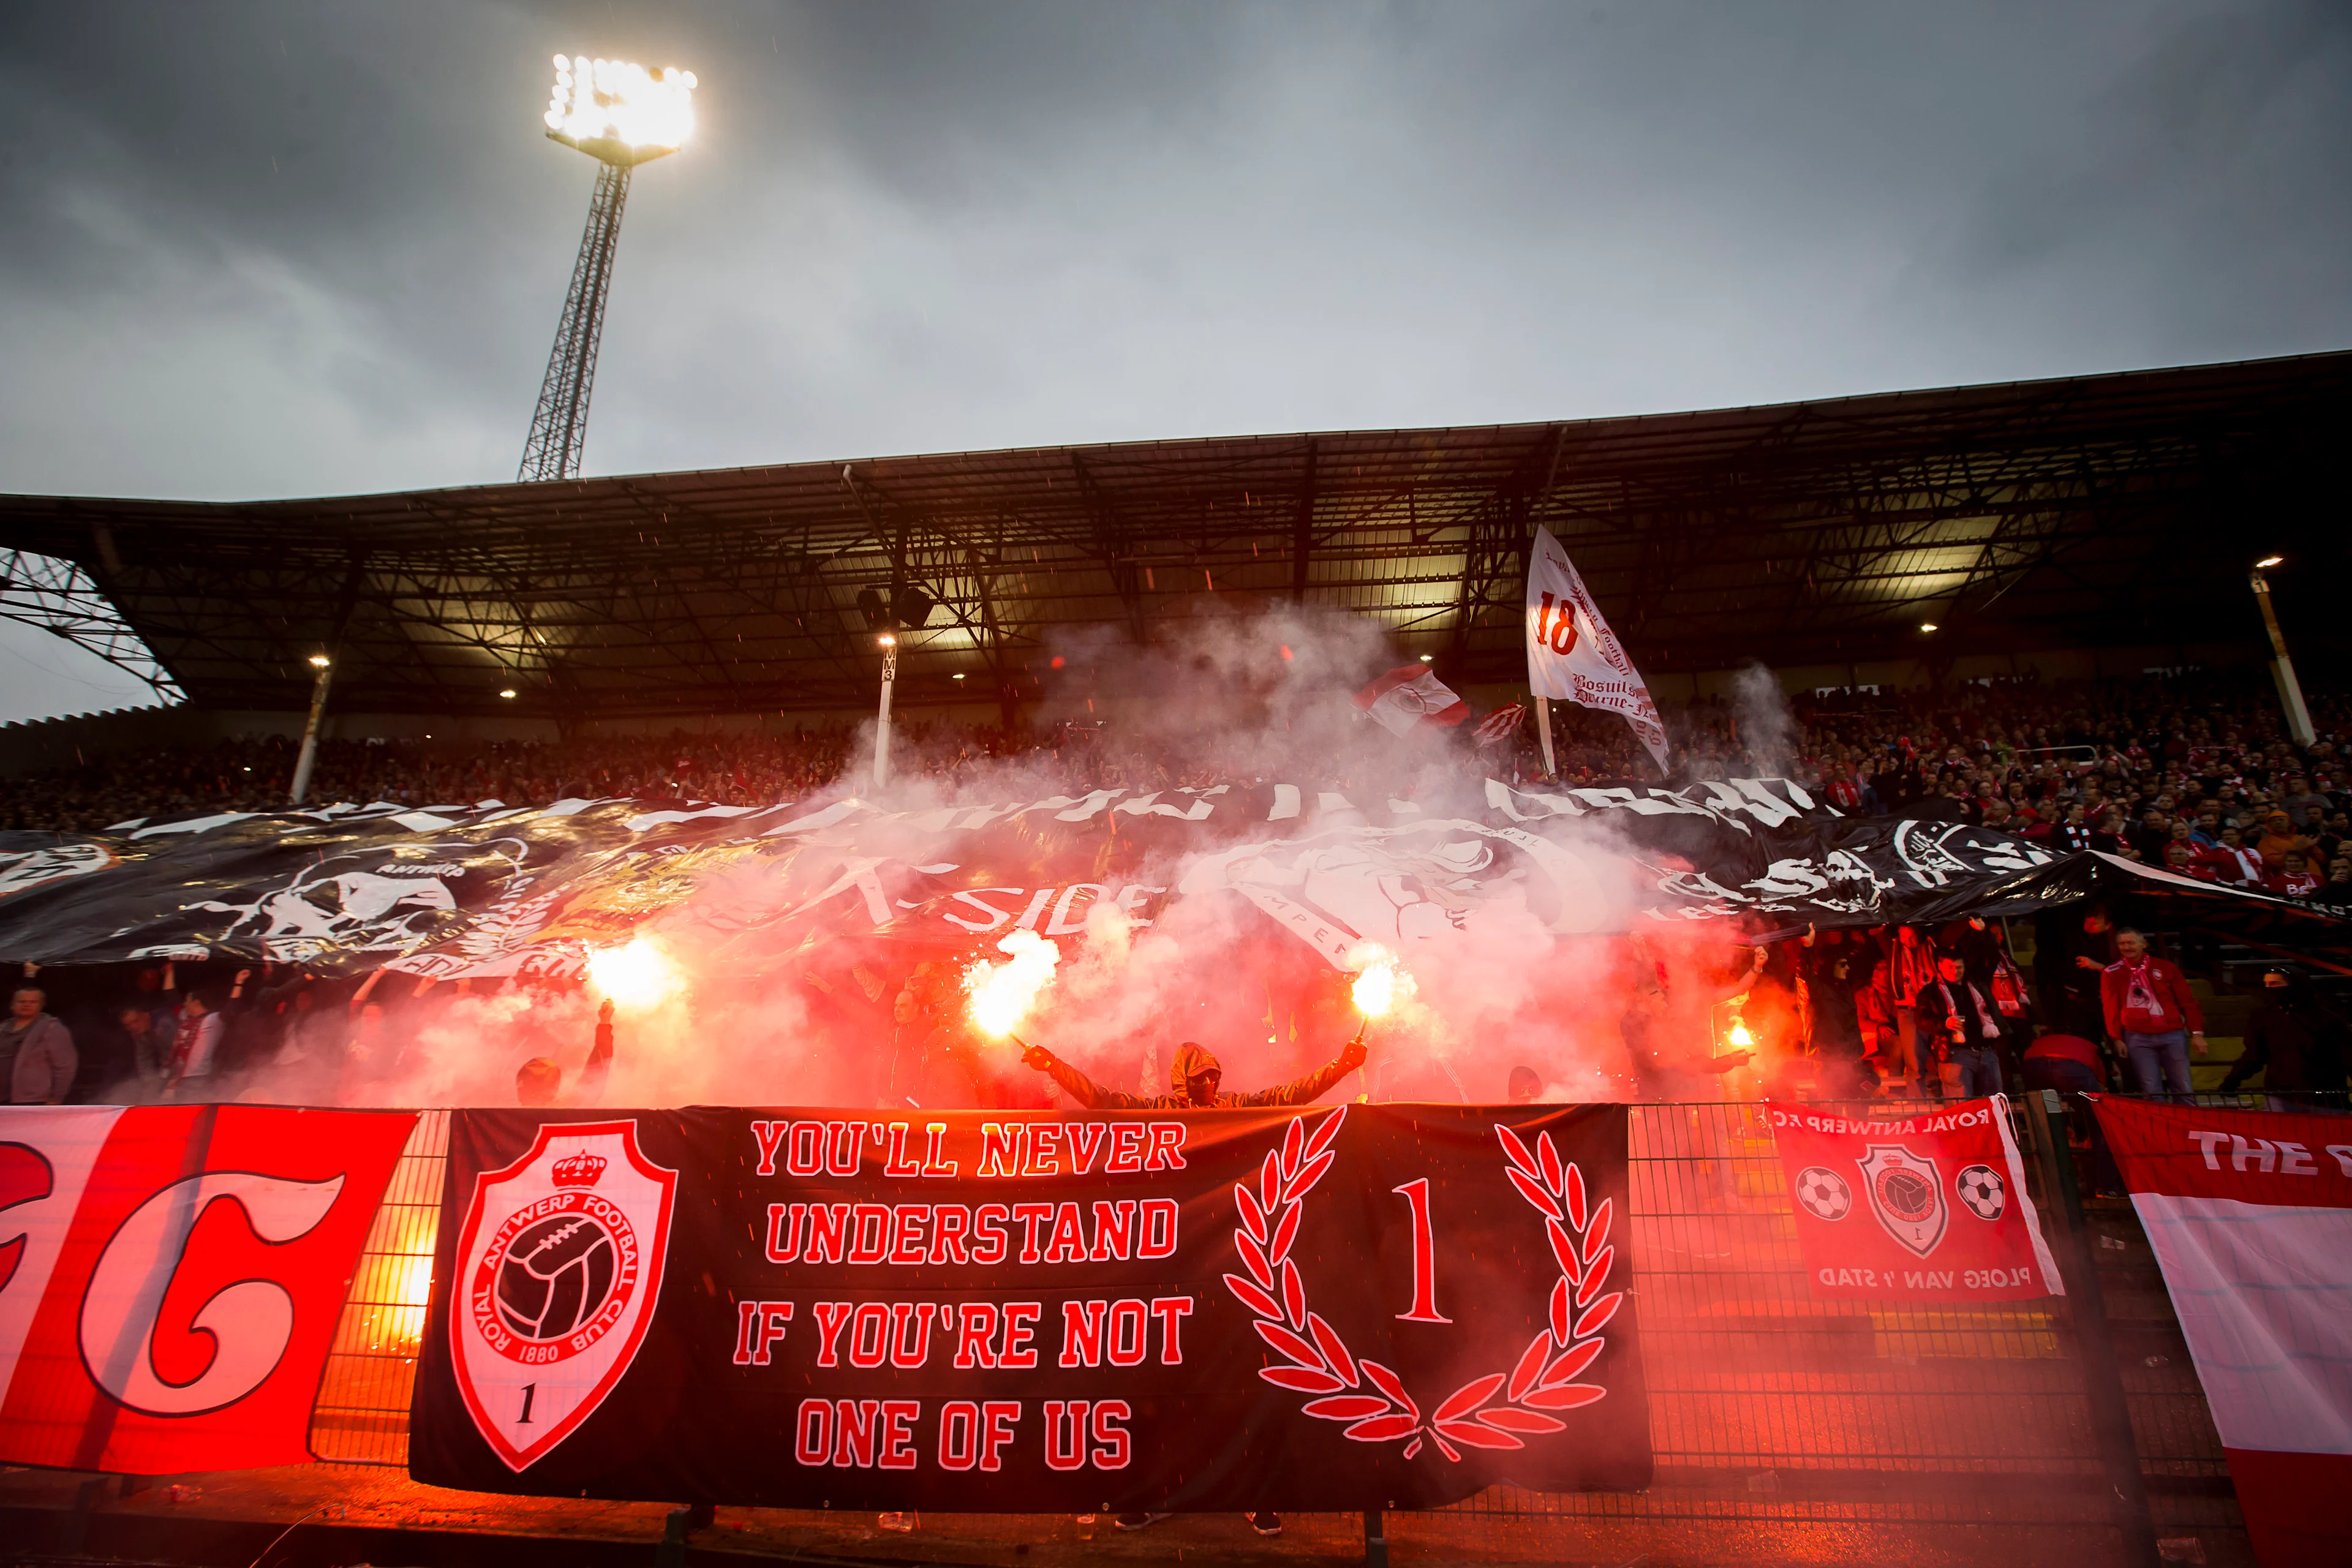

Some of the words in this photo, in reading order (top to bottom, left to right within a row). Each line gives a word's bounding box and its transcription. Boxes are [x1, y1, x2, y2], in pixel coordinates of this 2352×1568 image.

[1537, 590, 1578, 655] 18
[751, 1120, 957, 1177] YOU'LL
[977, 1121, 1188, 1177] NEVER
[2188, 1131, 2318, 1175] THE
[483, 1194, 576, 1270] ANTWERP
[582, 1196, 638, 1291] FOOTBALL
[764, 1197, 1179, 1265] UNDERSTAND
[1391, 1177, 1453, 1323] 1
[473, 1284, 512, 1352] ROYAL
[570, 1299, 624, 1352] CLUB
[733, 1300, 794, 1366] IF
[813, 1302, 1041, 1370] YOU'RE
[1058, 1296, 1194, 1368] NOT
[519, 1345, 558, 1363] 1880
[514, 1382, 537, 1423] 1
[795, 1398, 921, 1469] ONE
[938, 1400, 1022, 1472] OF
[1043, 1400, 1131, 1471] US
